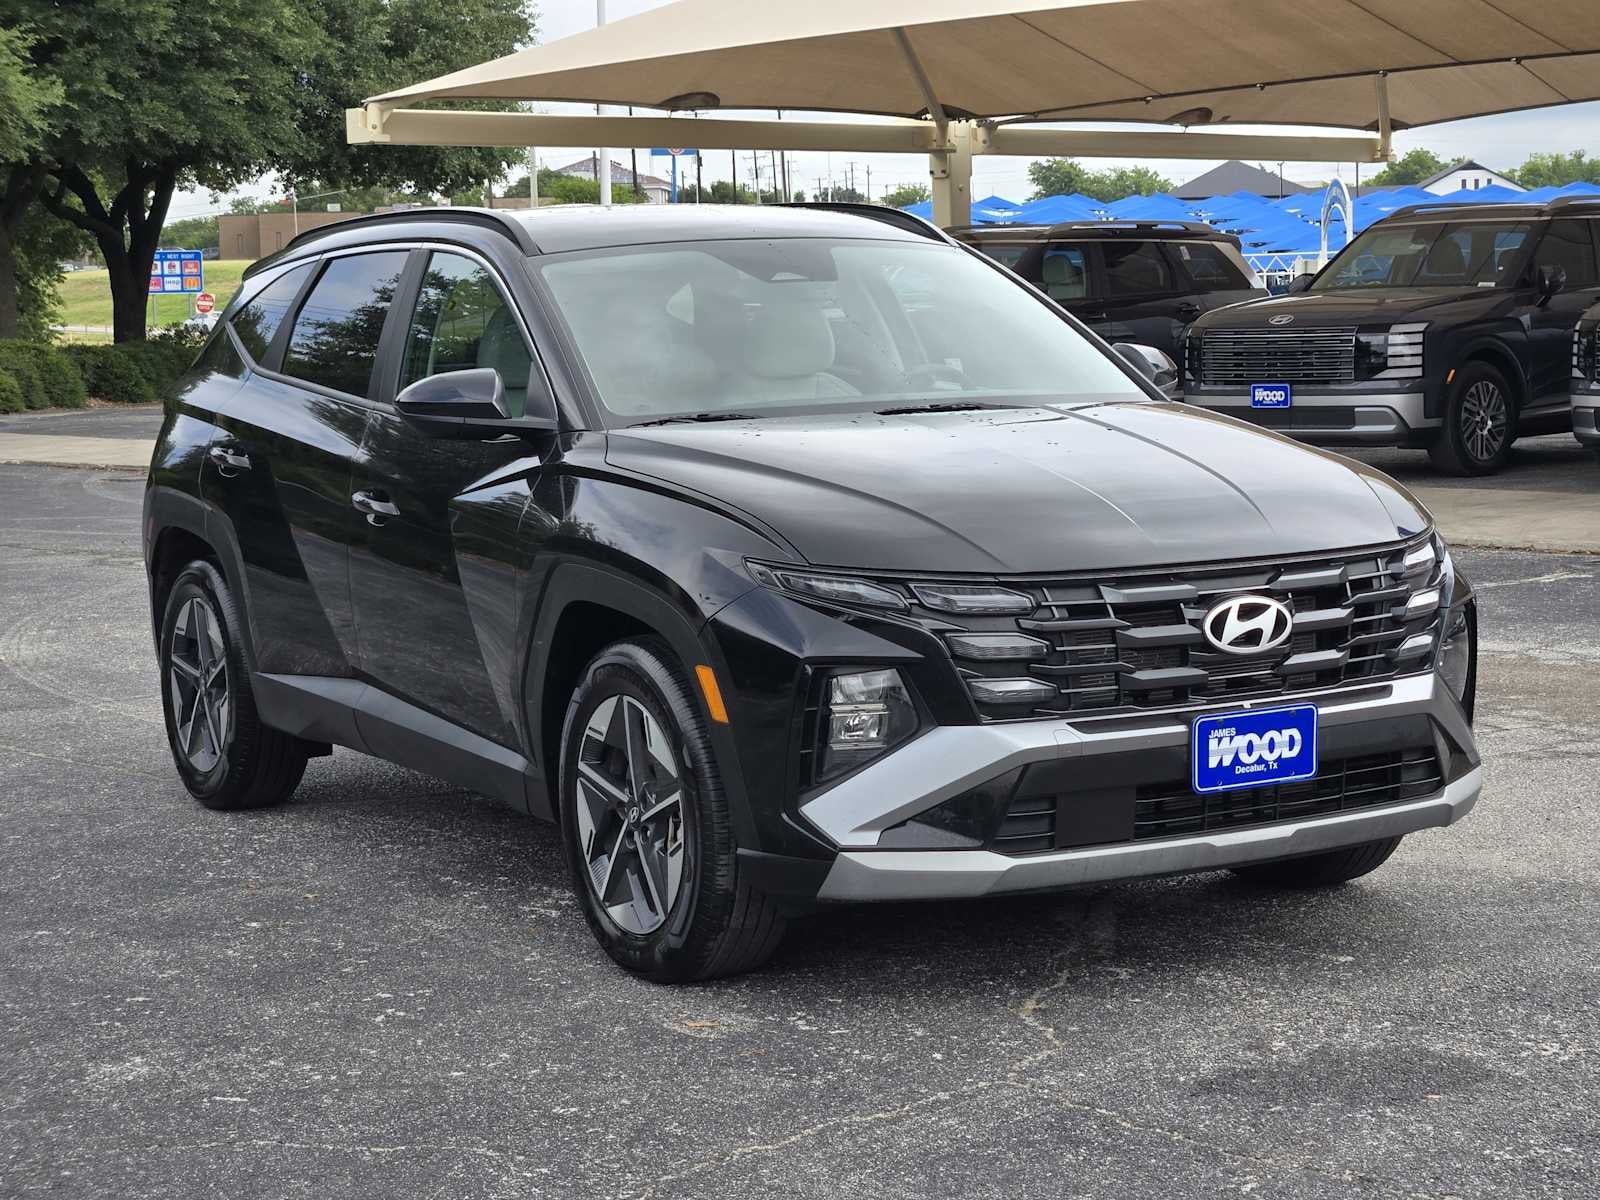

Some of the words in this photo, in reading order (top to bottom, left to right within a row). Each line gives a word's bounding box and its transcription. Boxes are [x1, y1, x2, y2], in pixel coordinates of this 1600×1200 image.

[1255, 390, 1285, 401] WOOD
[1208, 727, 1236, 739] JAMES
[1208, 728, 1302, 768] WOOD
[1235, 763, 1267, 774] Decatur,
[1268, 761, 1278, 769] Tx
